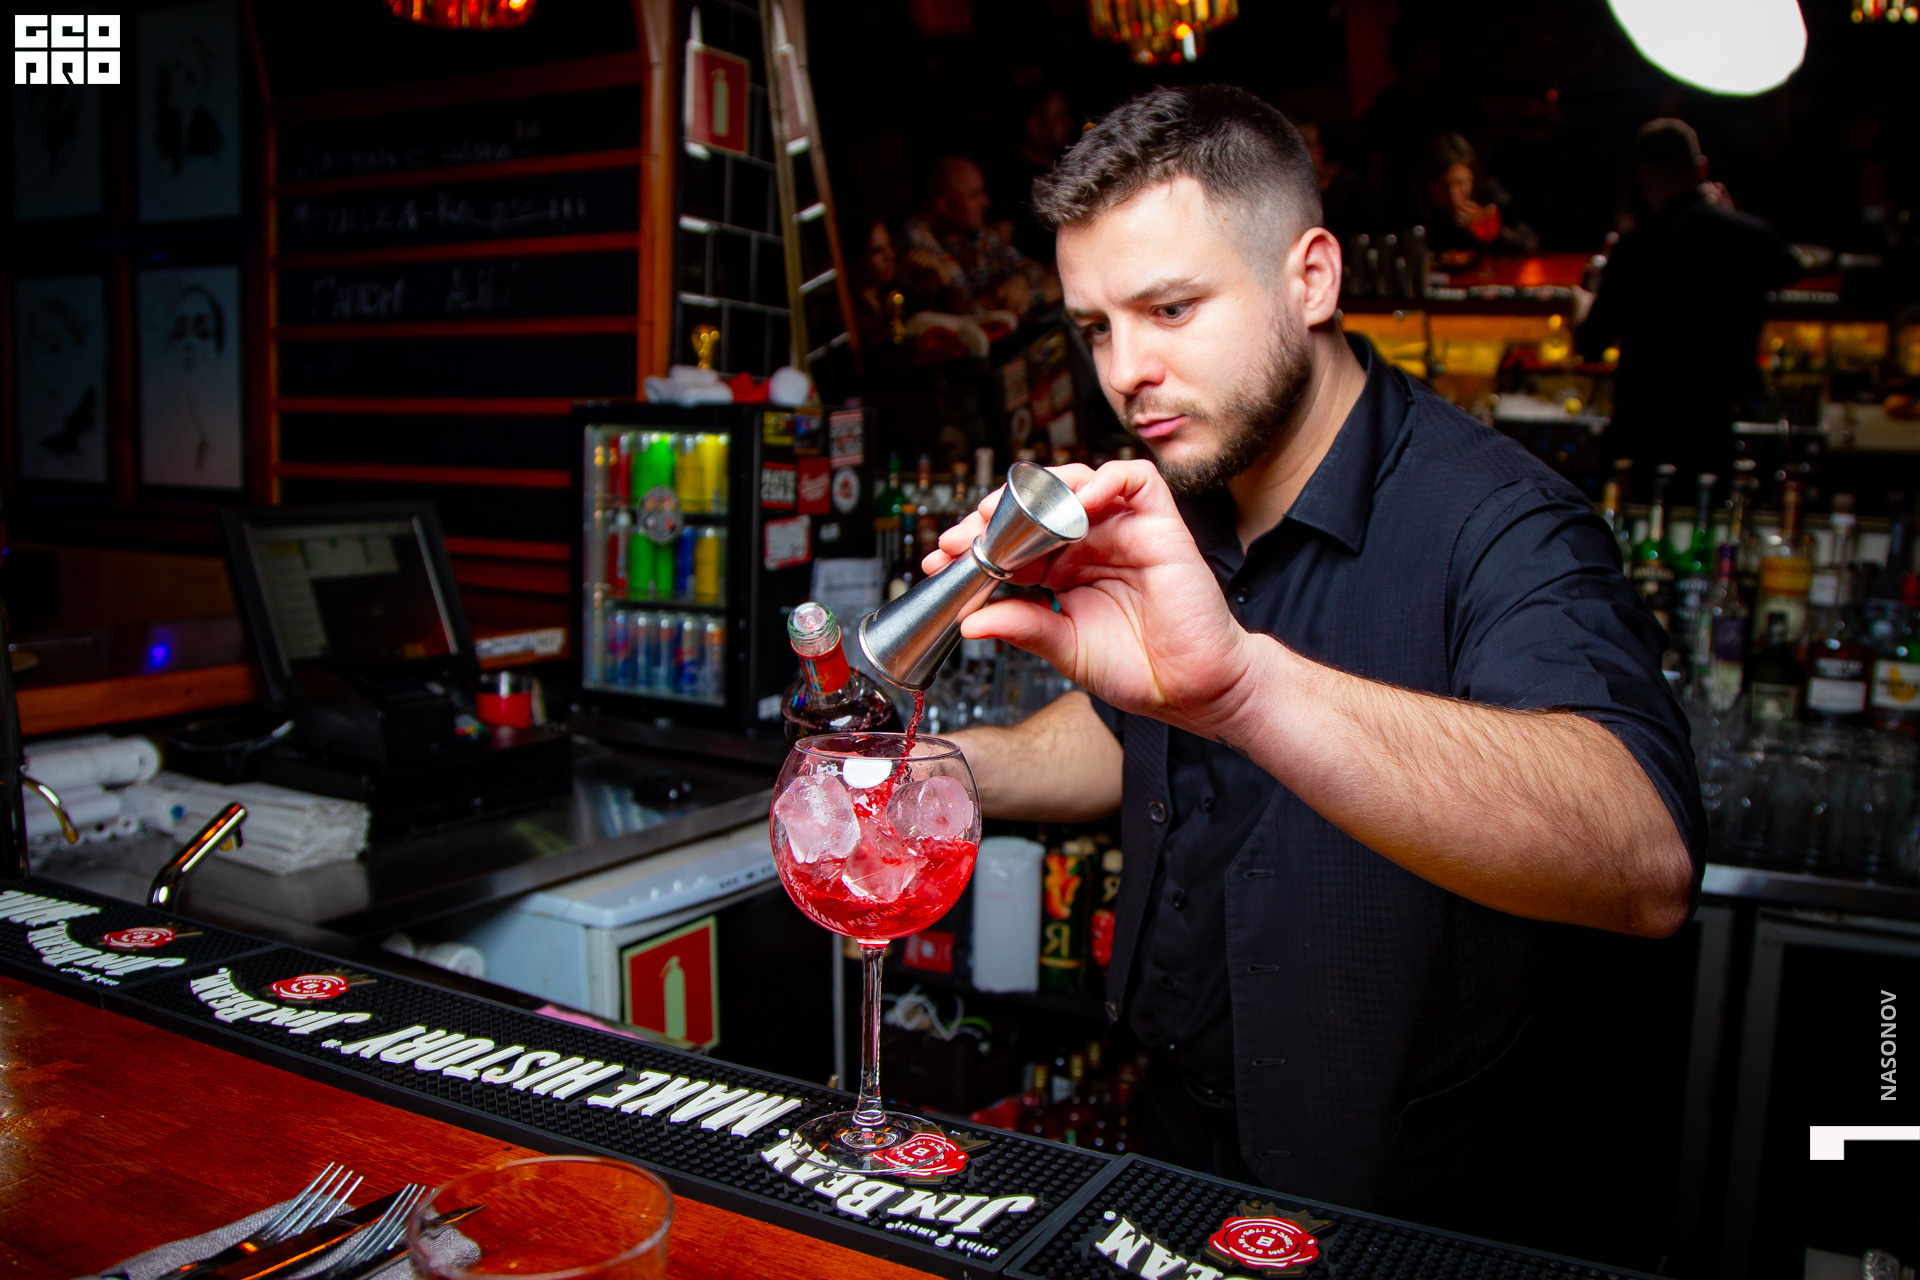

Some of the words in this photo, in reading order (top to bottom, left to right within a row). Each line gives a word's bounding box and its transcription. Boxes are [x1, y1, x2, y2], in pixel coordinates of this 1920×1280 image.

[73, 953, 187, 976] JIM
[189, 970, 278, 1023] BEAM
[249, 1006, 372, 1034] JIM
[587, 1070, 802, 1137] MAKE
[760, 1131, 905, 1218] BEAM
[886, 1190, 1037, 1233] JIM
[1094, 1216, 1245, 1280] EAM
[1266, 1246, 1286, 1257] JIM
[1269, 1228, 1294, 1249] SINCE
